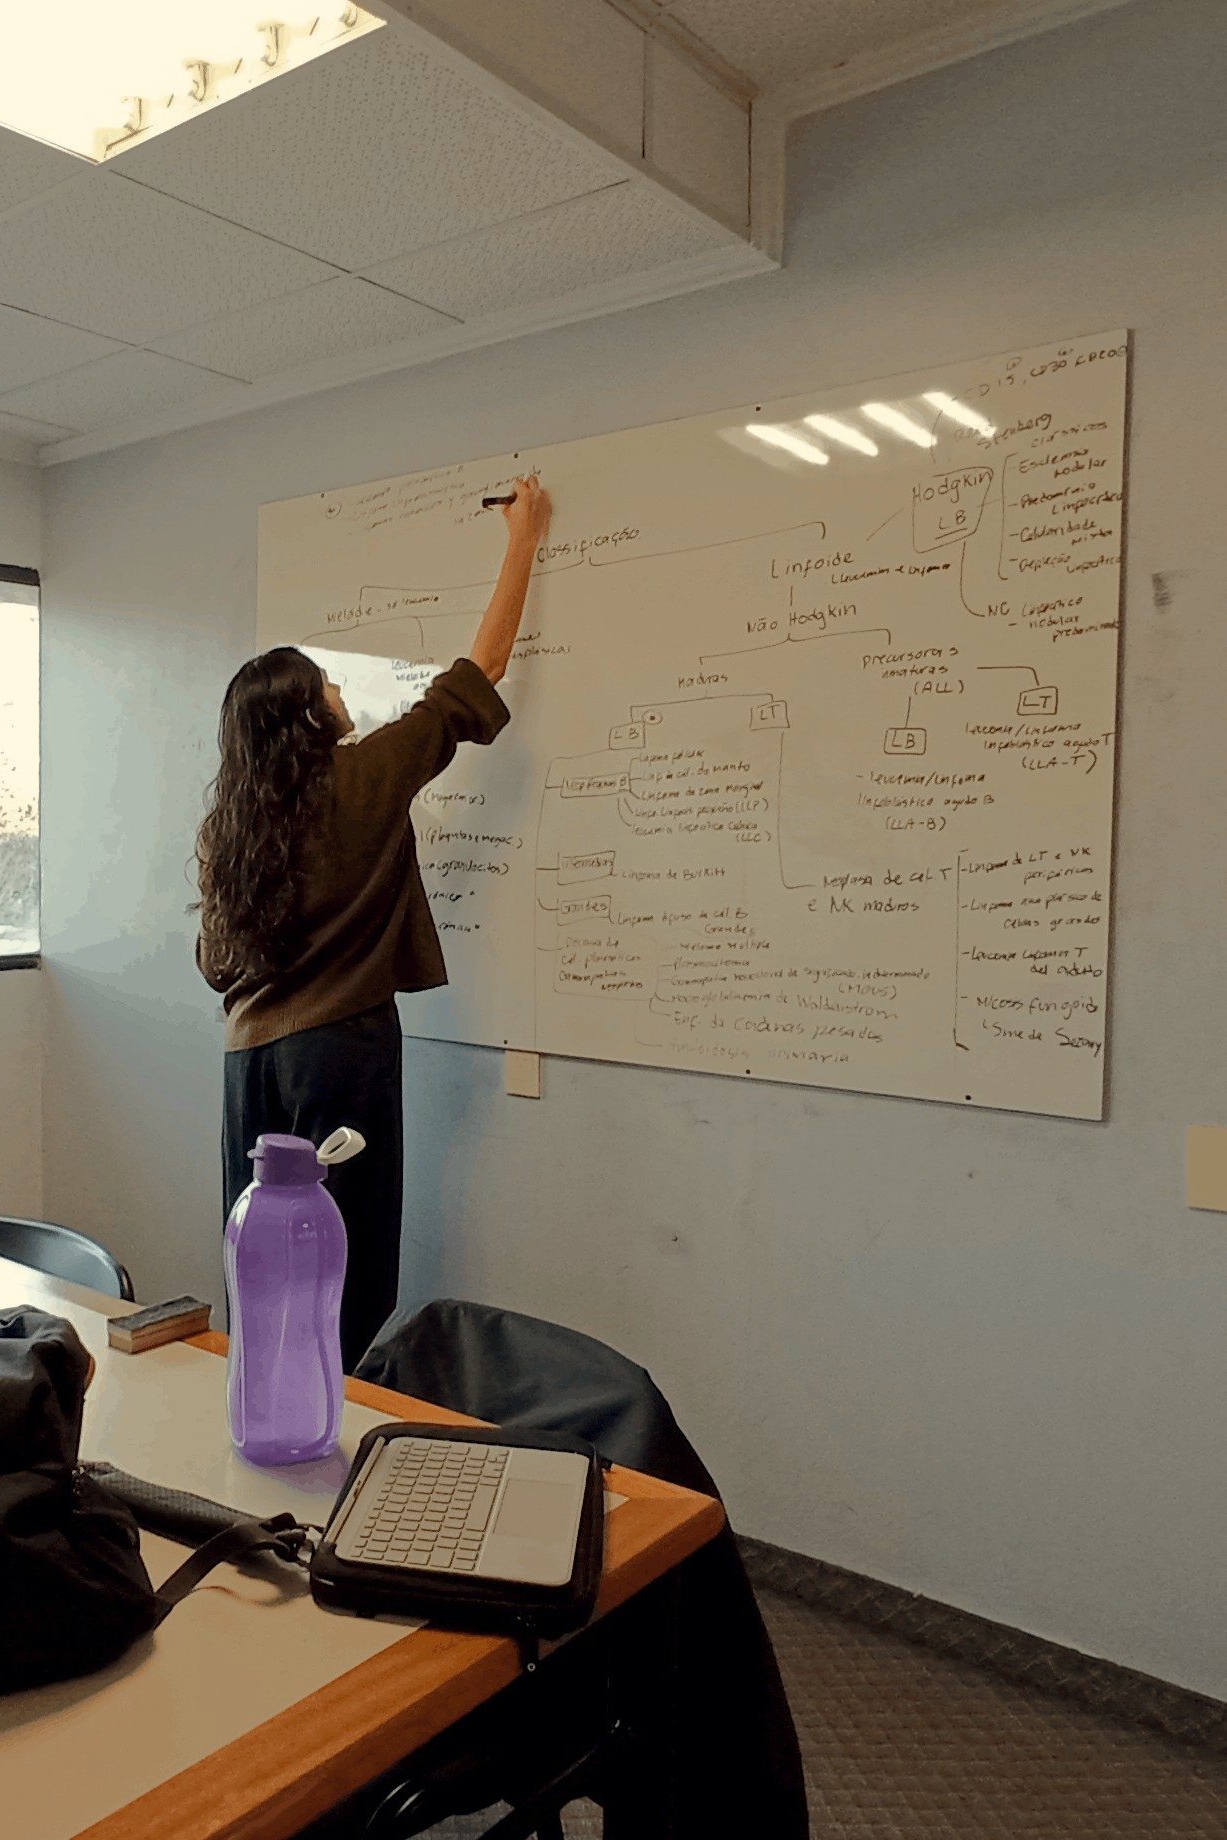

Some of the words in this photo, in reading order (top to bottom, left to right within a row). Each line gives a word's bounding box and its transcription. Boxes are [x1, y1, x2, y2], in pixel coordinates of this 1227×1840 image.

[912, 470, 993, 503] Hodgkin
[789, 602, 857, 630] Hodgkin
[890, 733, 916, 748] LB
